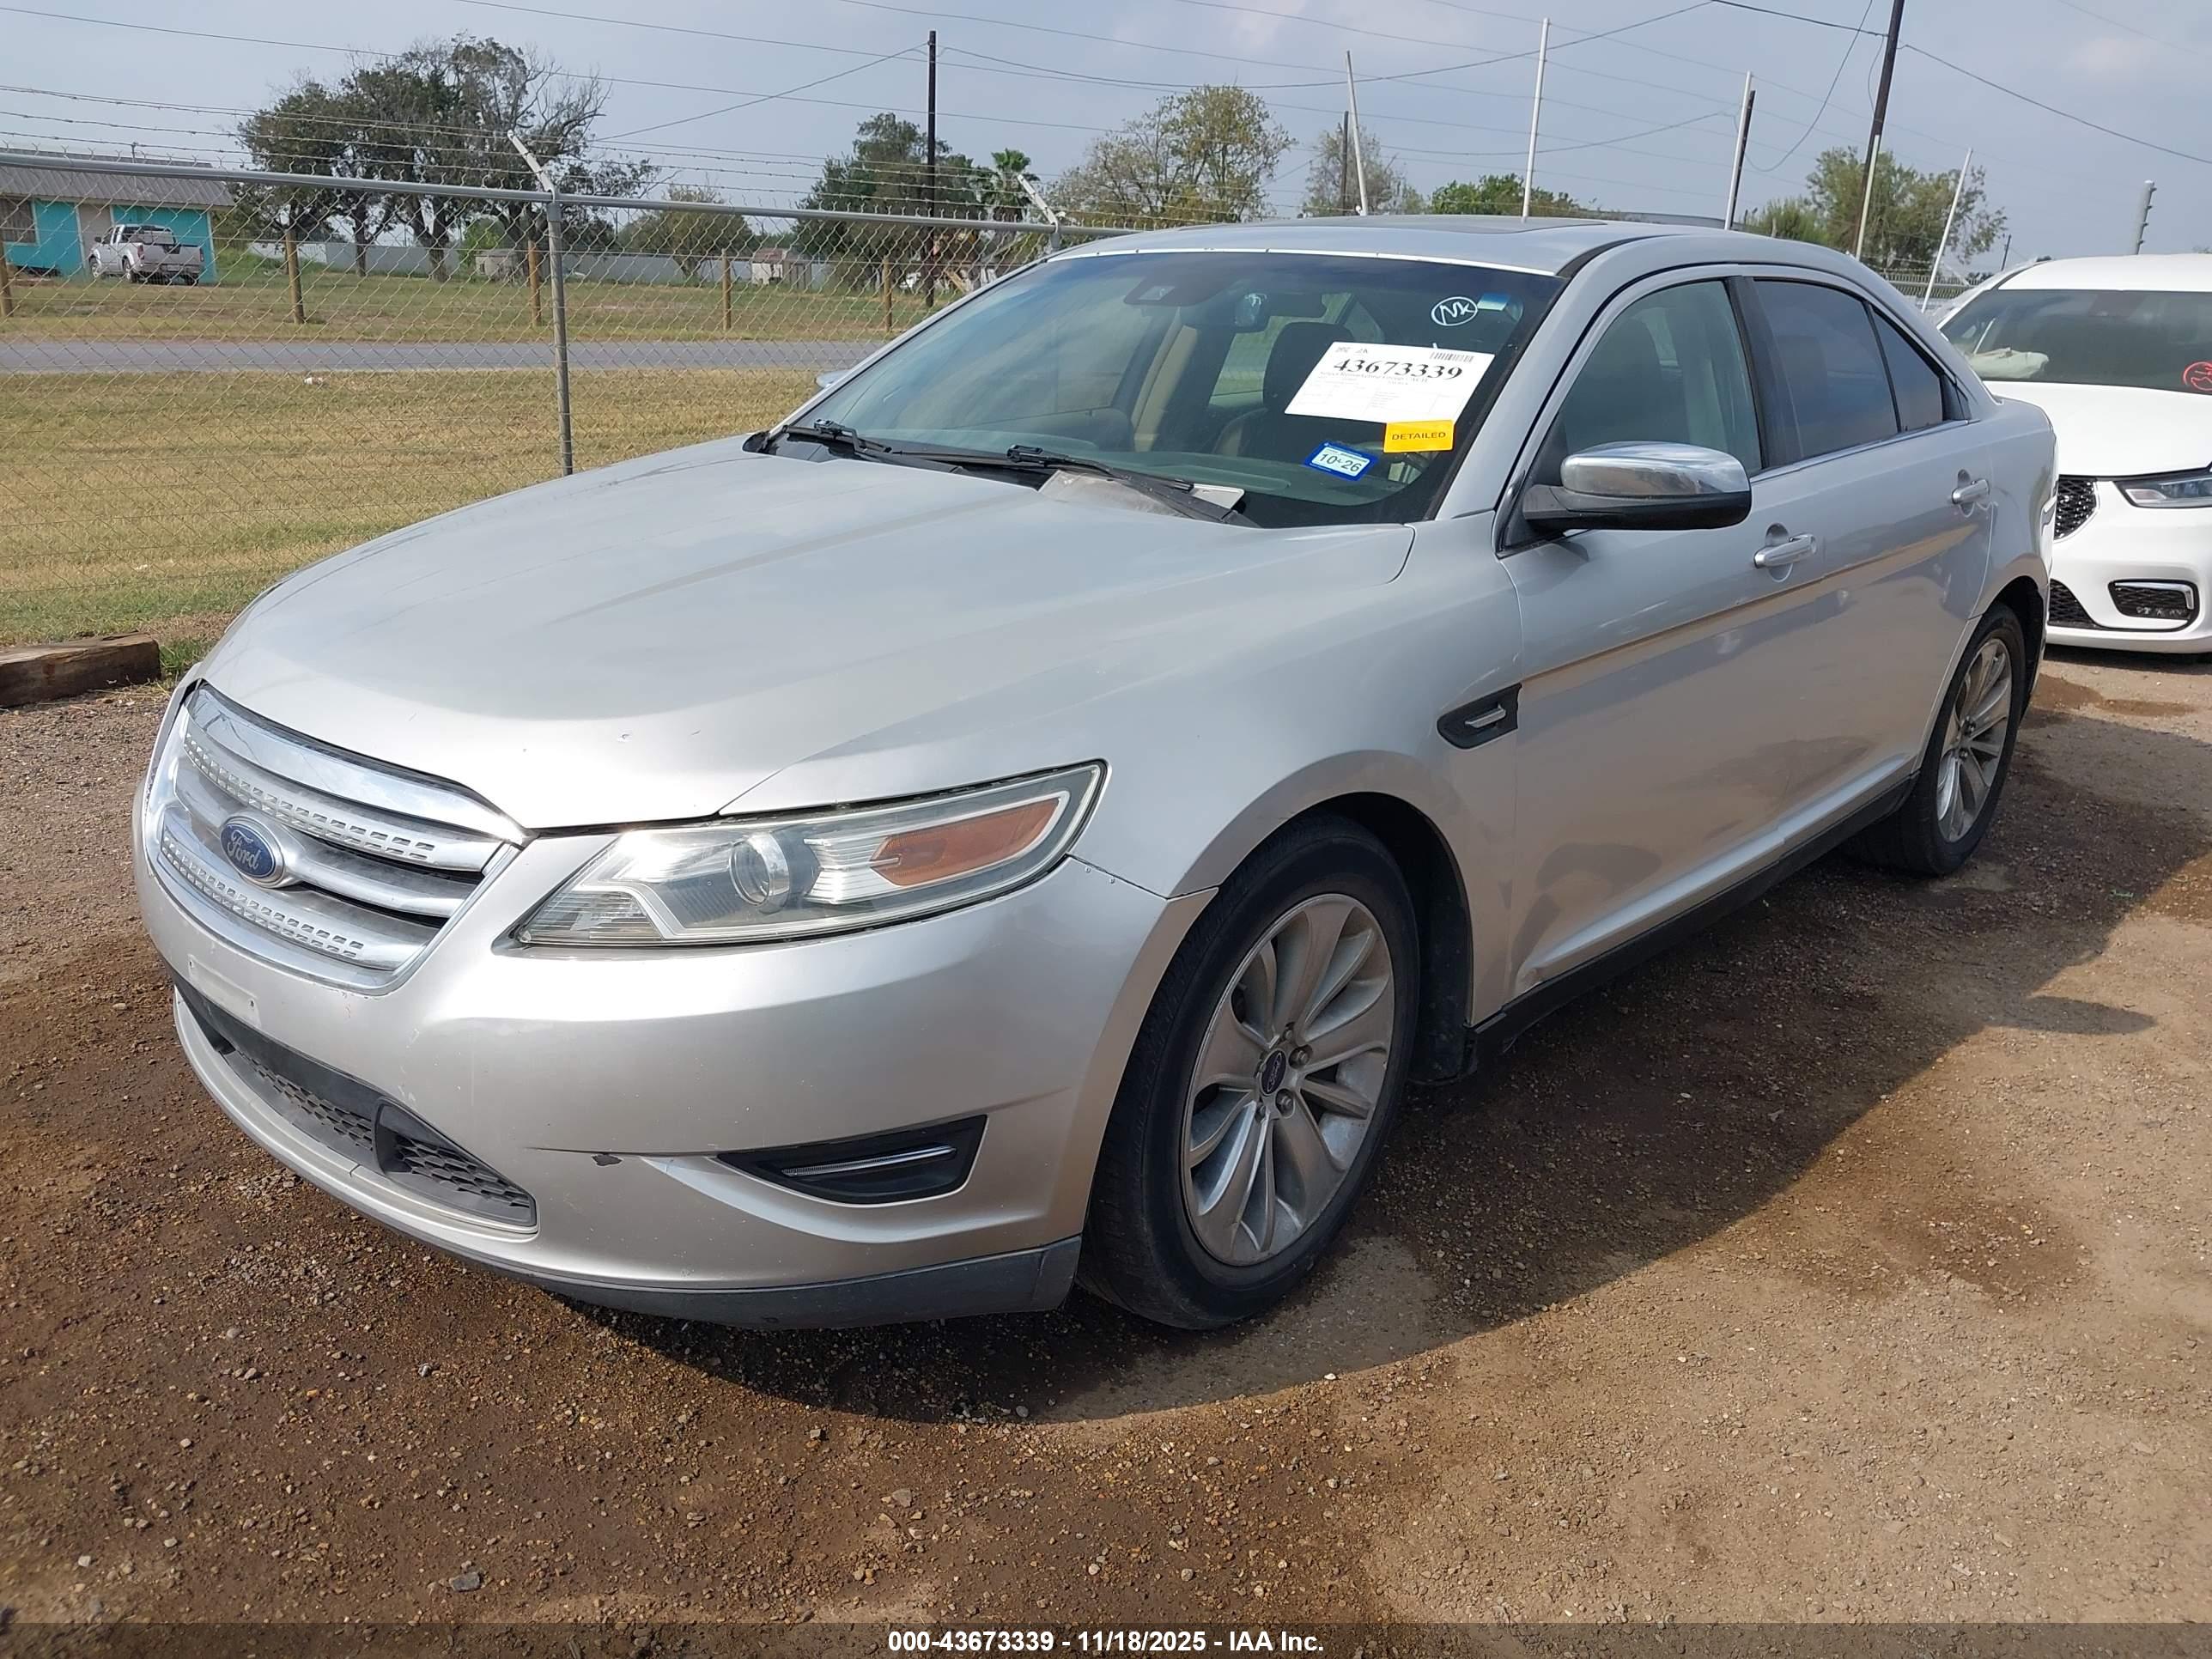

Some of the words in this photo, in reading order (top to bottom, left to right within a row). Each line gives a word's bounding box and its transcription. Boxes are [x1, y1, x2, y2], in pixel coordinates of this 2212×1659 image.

[1334, 358, 1463, 380] 43673339
[1391, 431, 1447, 441] DETAILED
[227, 829, 263, 870] Ford
